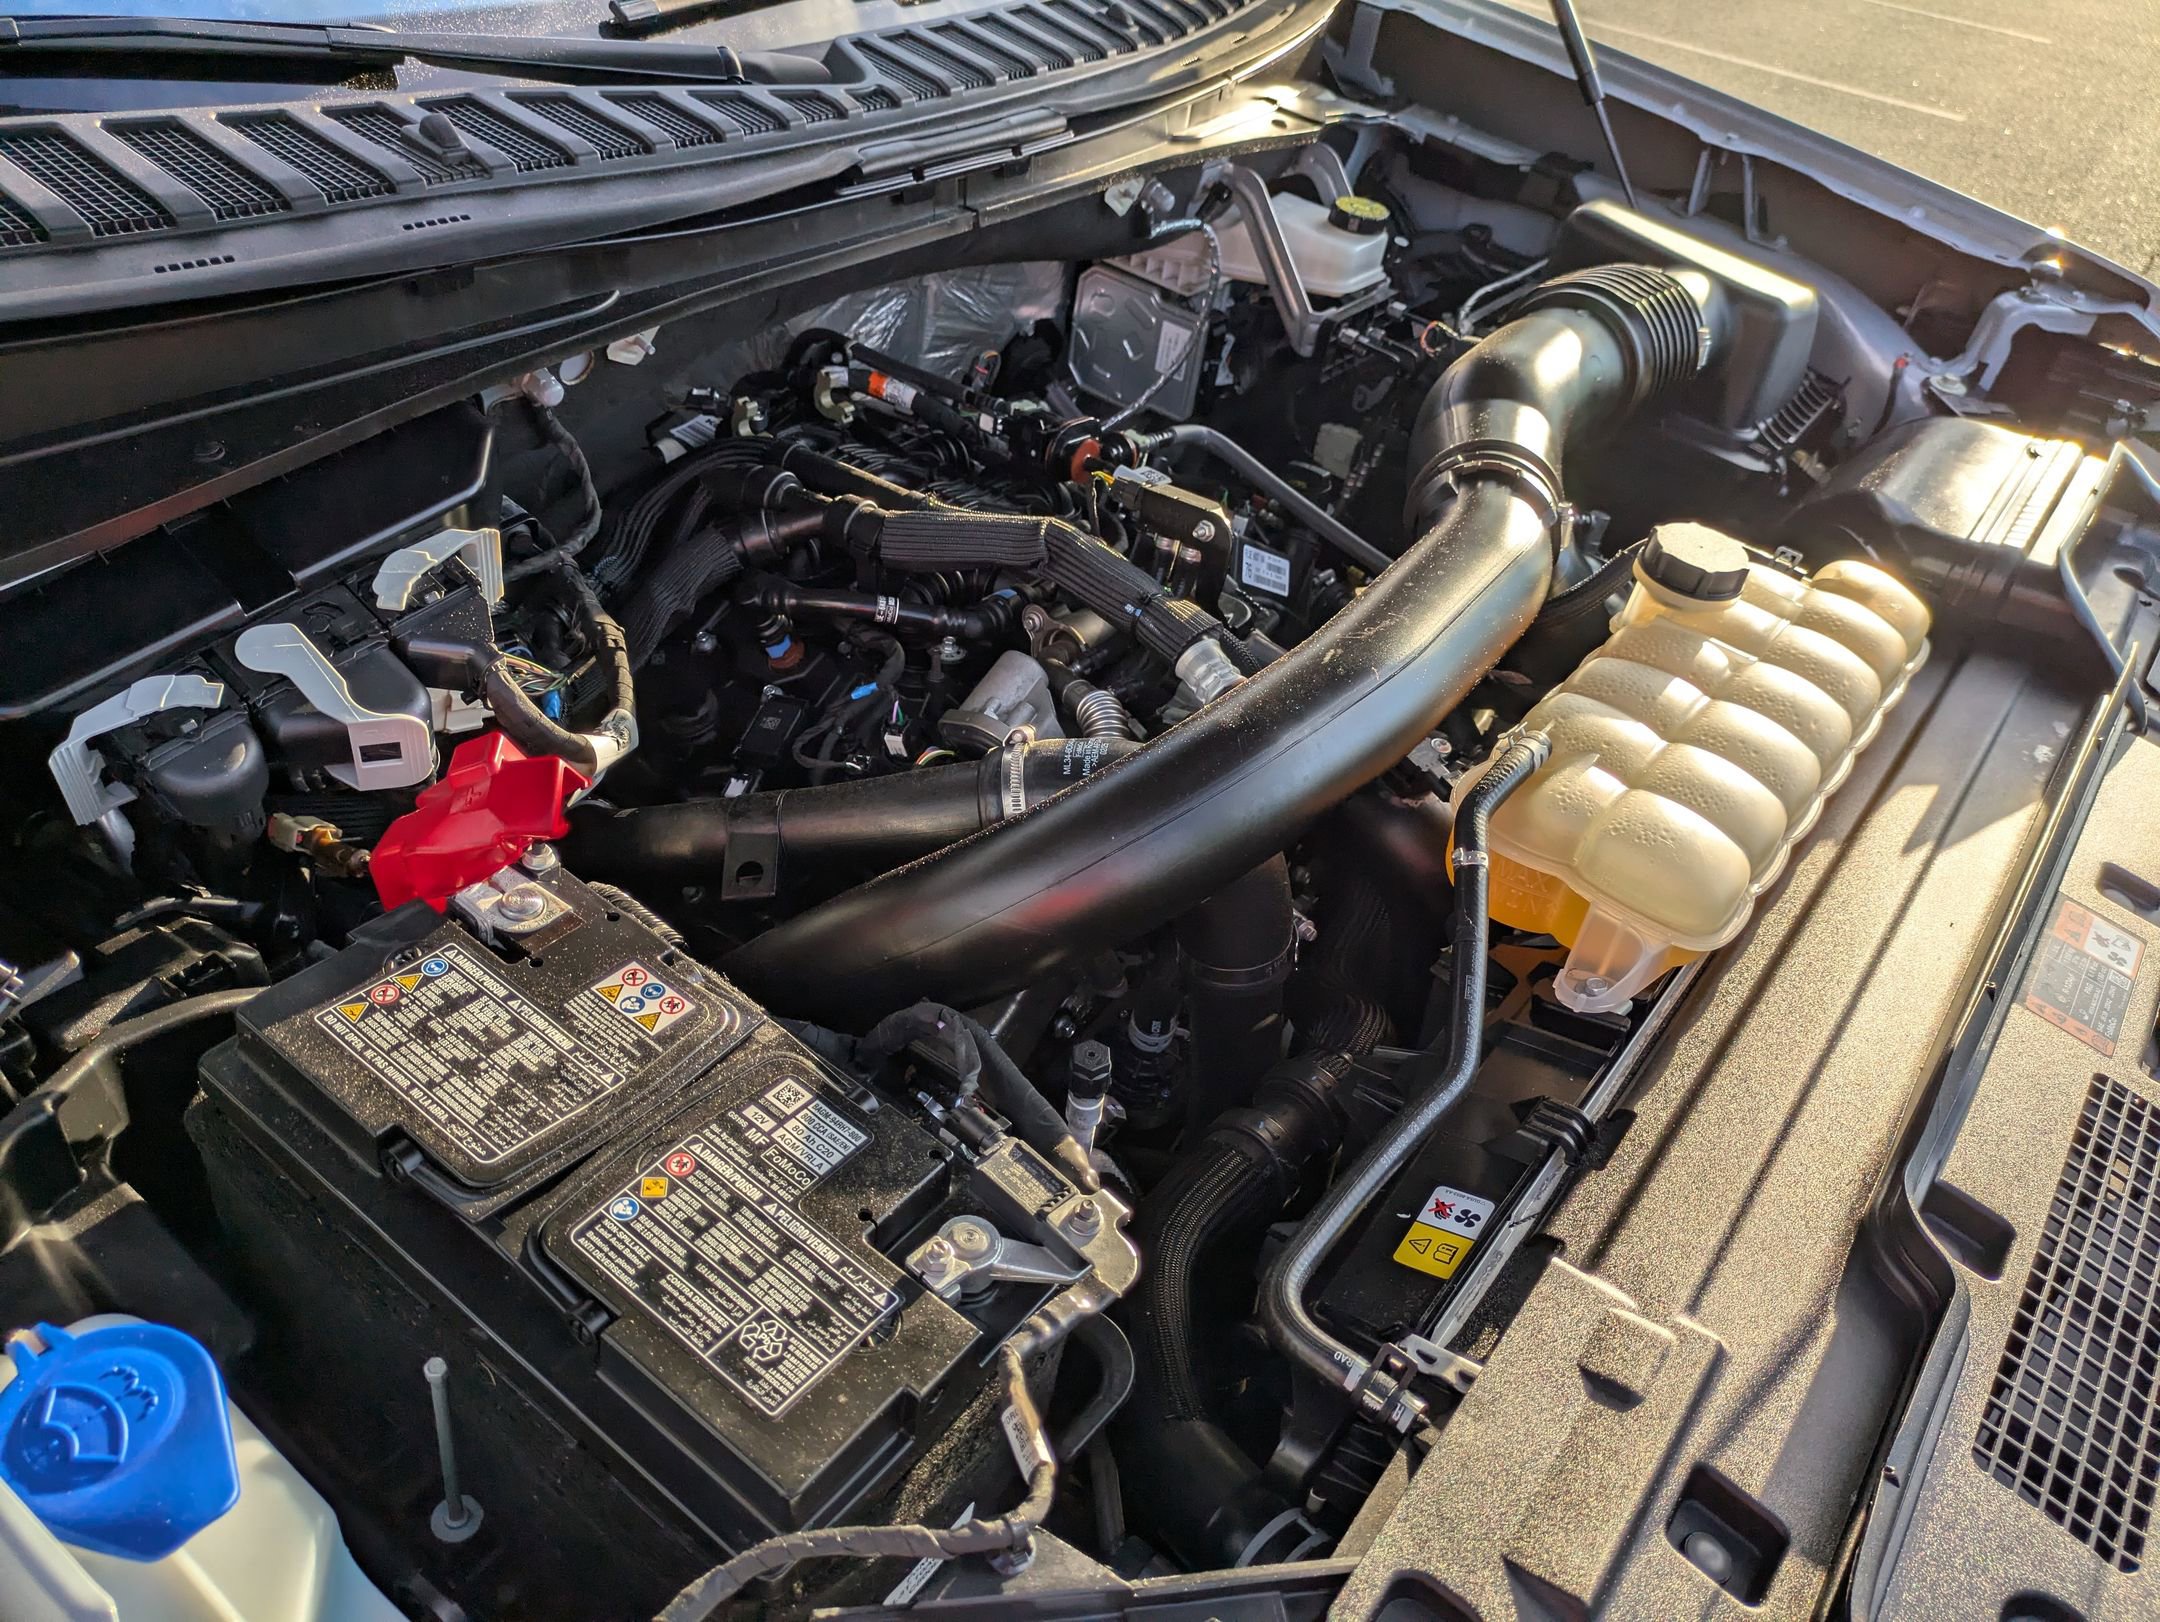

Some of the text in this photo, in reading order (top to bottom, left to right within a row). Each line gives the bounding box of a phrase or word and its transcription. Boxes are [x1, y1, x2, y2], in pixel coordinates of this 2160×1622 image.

[453, 954, 509, 998] DANGER/POISON
[323, 1015, 338, 1025] DO
[332, 1022, 349, 1035] NOT
[517, 1005, 575, 1050] PELIGRO/VENENO
[363, 1049, 378, 1059] NE
[372, 1057, 389, 1069] PAS
[409, 1088, 424, 1099] NO
[419, 1096, 433, 1107] LA
[751, 1111, 770, 1125] 12V
[800, 1113, 850, 1152] 800 CCA (SAE/EN)
[746, 1128, 769, 1147] MF
[778, 1133, 825, 1170] AGM/VRLA
[792, 1125, 835, 1158] 80 Ah C20
[700, 1148, 763, 1202] DANGER/POISON
[766, 1149, 813, 1186] FoMoCo
[587, 1230, 637, 1276] Batterie au plomb
[595, 1224, 646, 1270] Lead Acid Battery
[603, 1219, 652, 1262] NON-SPILLABLE
[775, 1209, 840, 1265] PELIGRO/VENENO
[577, 1237, 641, 1290] ANTI DÉVERSEMENT
[667, 1273, 730, 1328] CONTRA DERRAMES
[758, 1332, 773, 1345] Pb
[1334, 1351, 1354, 1368] RAD
